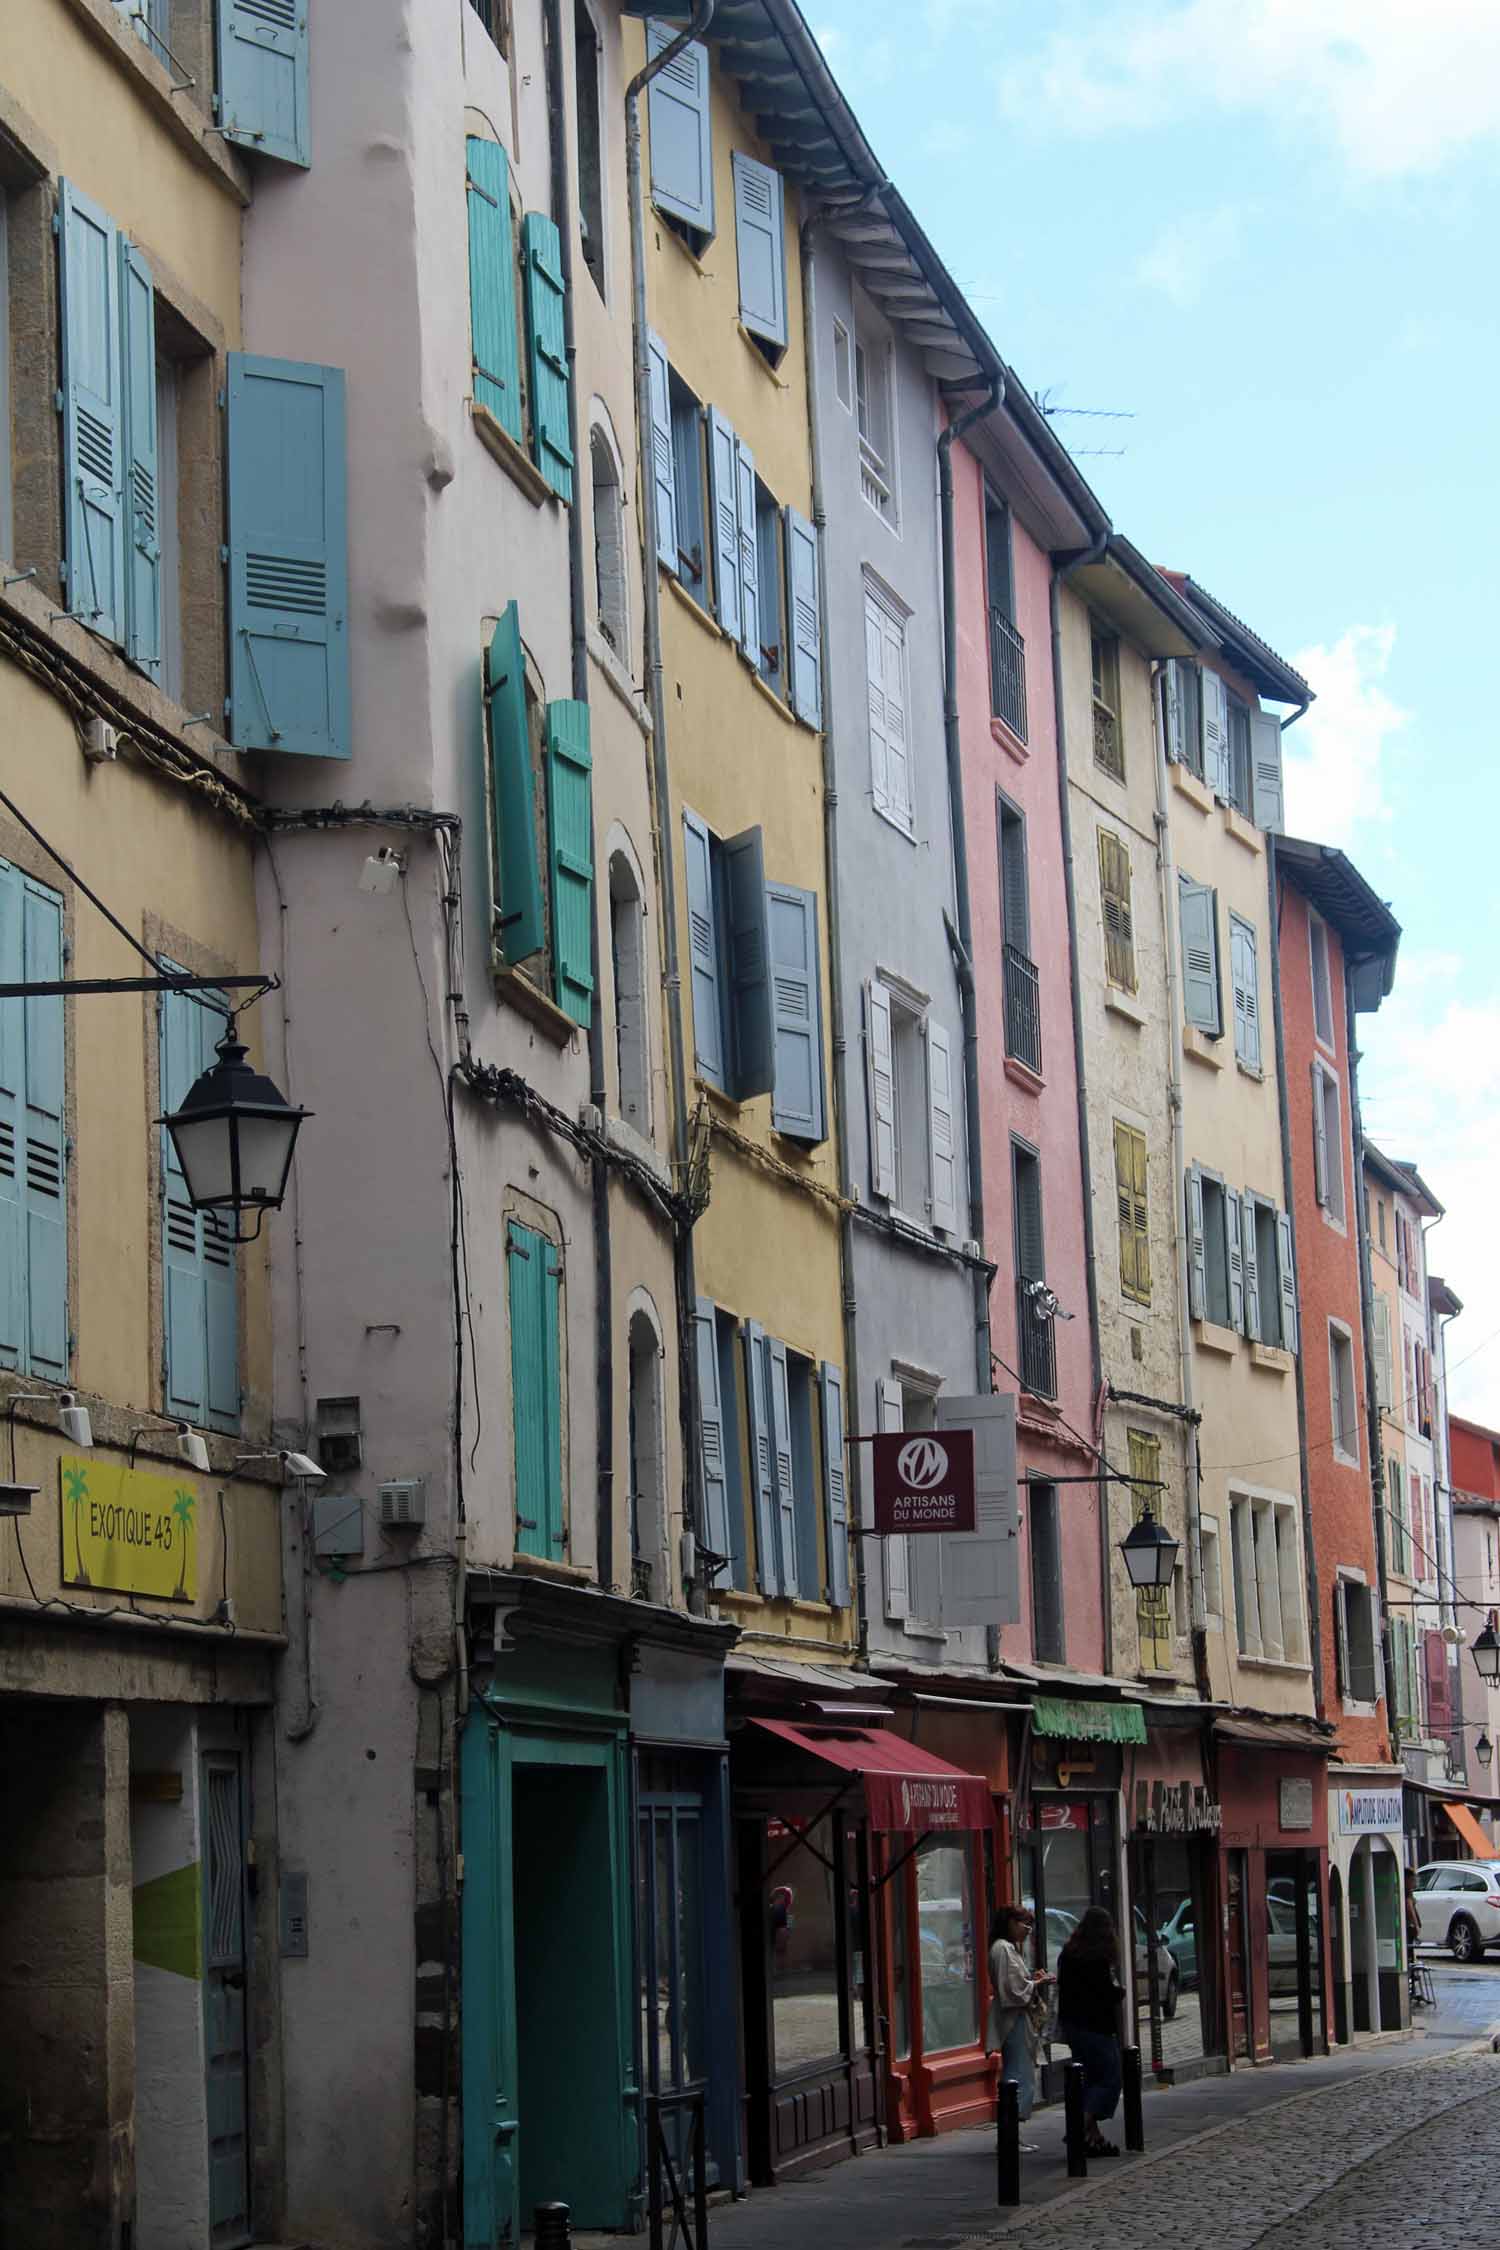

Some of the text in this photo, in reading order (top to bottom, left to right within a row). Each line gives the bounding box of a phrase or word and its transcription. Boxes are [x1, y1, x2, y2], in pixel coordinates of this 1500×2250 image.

[894, 1495, 956, 1508] ARTISANS
[893, 1507, 956, 1521] DU MONDE
[90, 1502, 172, 1550] EXOTIQUE 43
